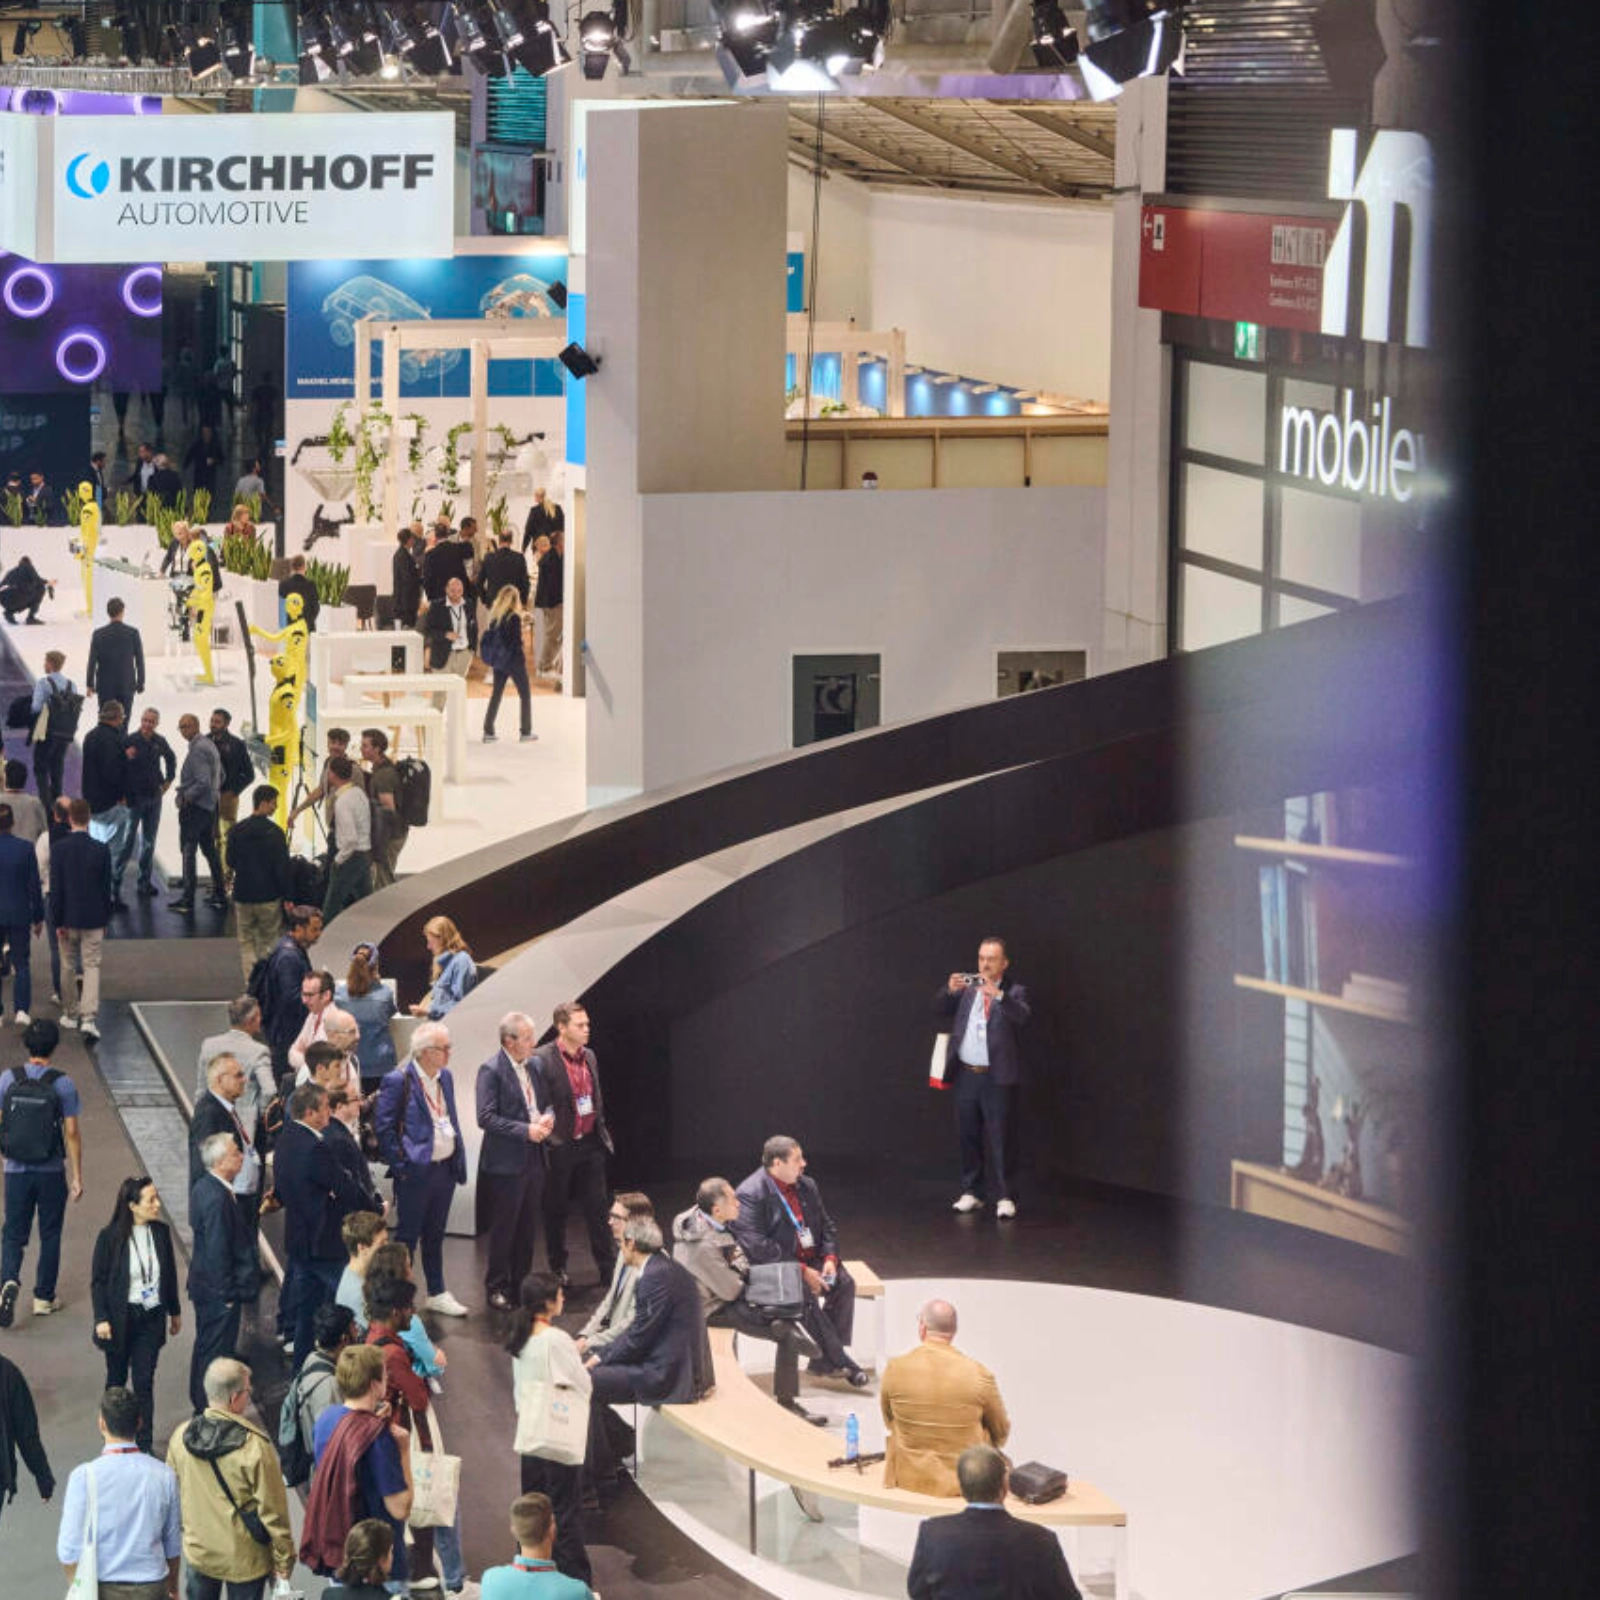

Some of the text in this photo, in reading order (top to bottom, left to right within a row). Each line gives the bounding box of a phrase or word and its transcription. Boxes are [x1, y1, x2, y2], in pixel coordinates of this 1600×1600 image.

[119, 153, 434, 193] KIRCHHOFF
[117, 200, 310, 226] AUTOMOTIVE
[1279, 388, 1422, 504] mobile
